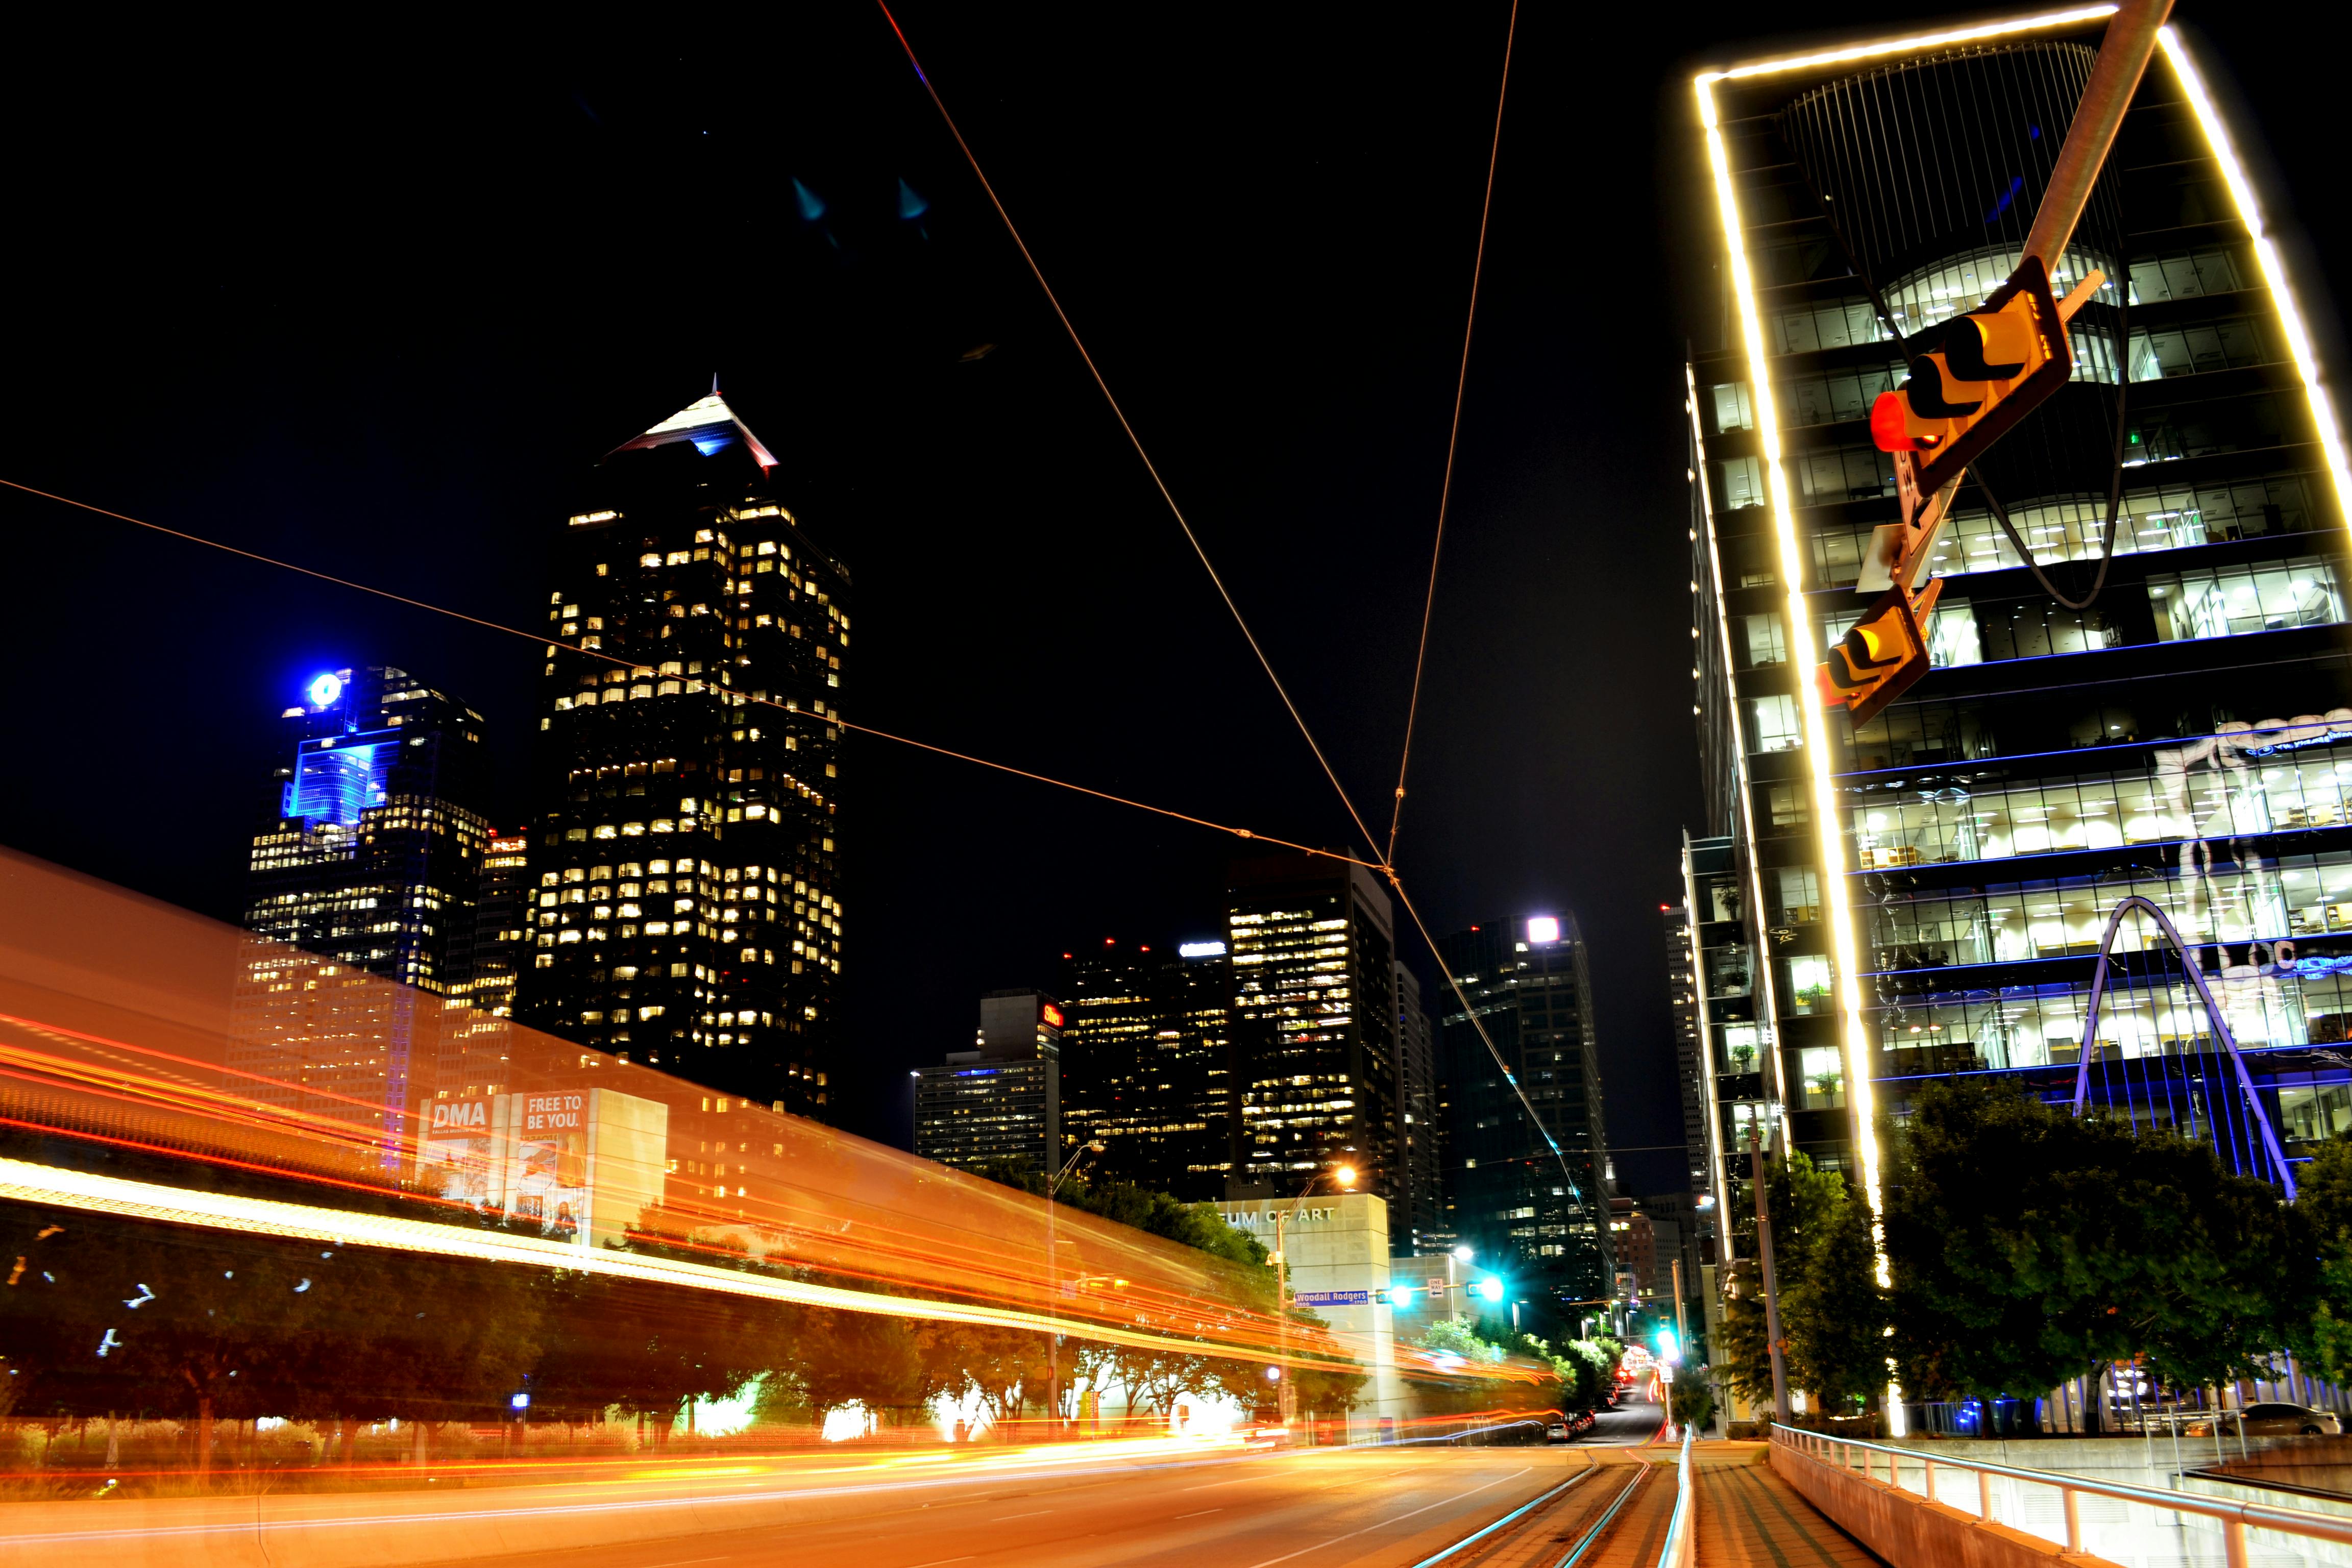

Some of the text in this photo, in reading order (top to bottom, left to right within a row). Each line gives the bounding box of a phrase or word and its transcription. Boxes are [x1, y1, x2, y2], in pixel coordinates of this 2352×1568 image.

[529, 1095, 581, 1112] FREE TO
[433, 1102, 486, 1128] DMA
[528, 1113, 578, 1129] BE YOU.
[1266, 1210, 1290, 1223] OF
[1298, 1207, 1334, 1221] ART
[1297, 1292, 1366, 1302] Woodall Rodgers
